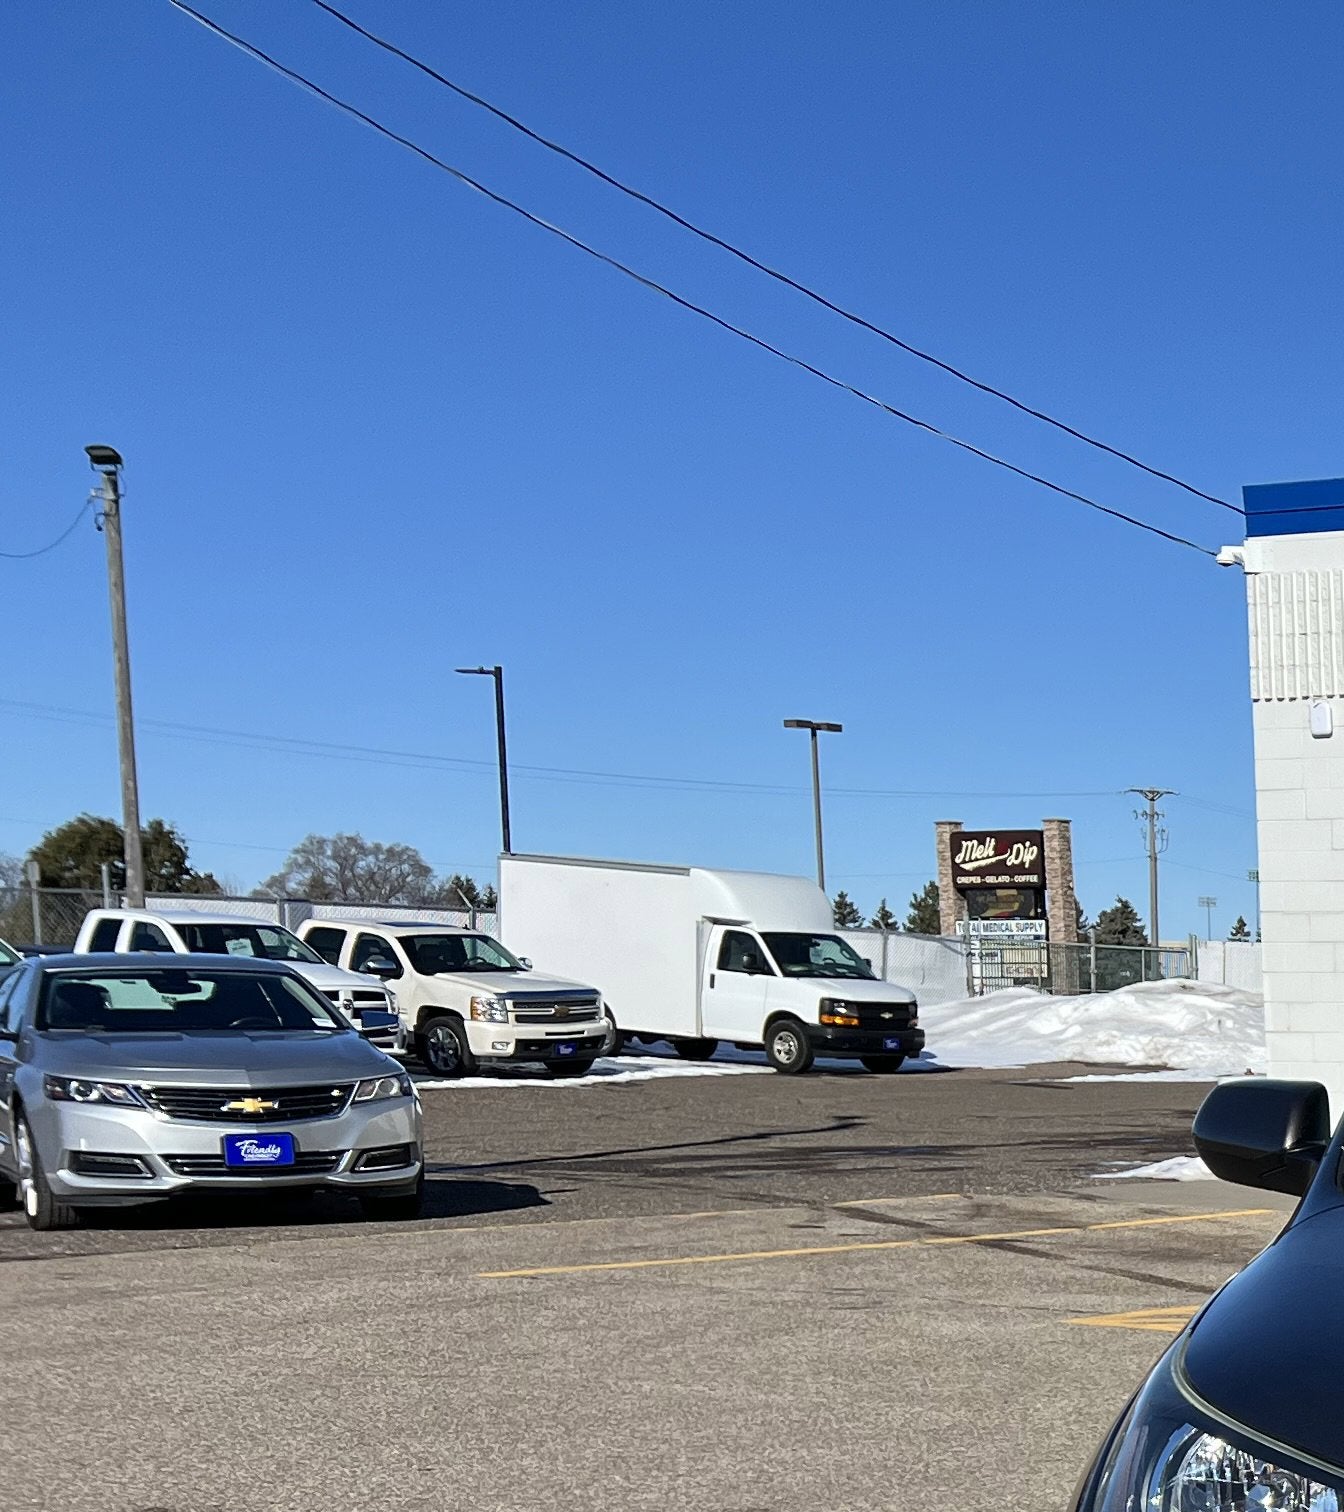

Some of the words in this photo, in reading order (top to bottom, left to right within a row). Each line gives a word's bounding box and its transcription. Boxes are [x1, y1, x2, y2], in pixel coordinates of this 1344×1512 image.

[955, 837, 996, 864] Melt
[1006, 841, 1038, 869] Dip
[1014, 875, 1039, 883] COFFEE
[957, 923, 981, 933] TAL
[983, 922, 1013, 932] MEDICAL
[1016, 922, 1043, 932] SUPPLY
